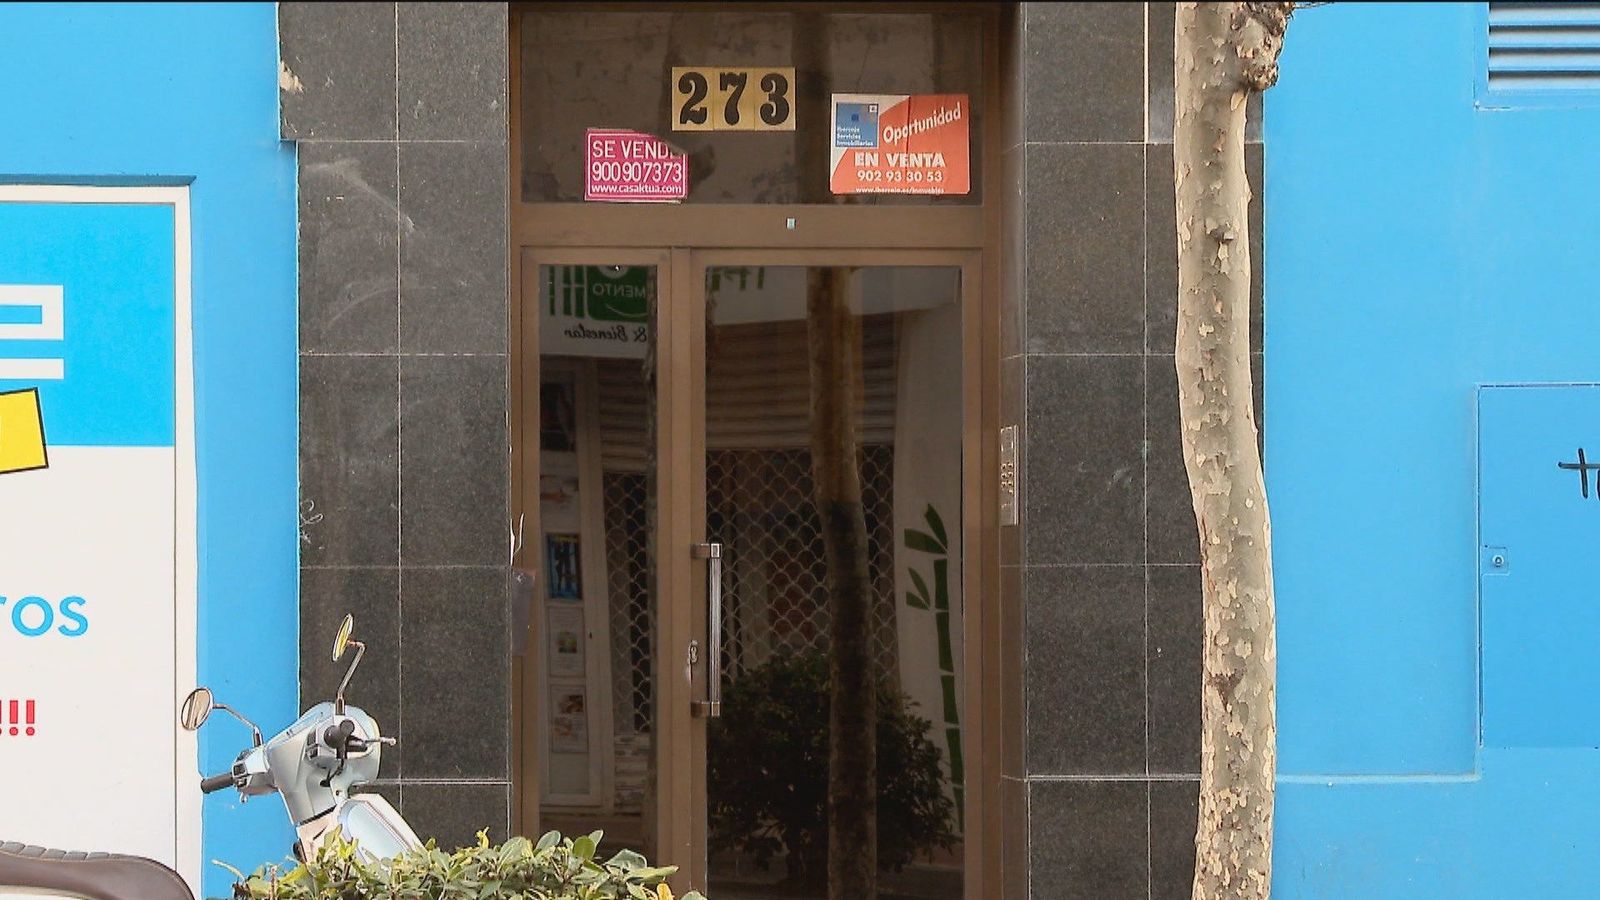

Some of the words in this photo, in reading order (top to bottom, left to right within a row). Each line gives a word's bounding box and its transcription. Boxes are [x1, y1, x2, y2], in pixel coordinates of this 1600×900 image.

[679, 72, 790, 126] 273
[883, 102, 962, 146] Oportunidad
[592, 140, 616, 158] SE
[854, 152, 879, 168] EN
[886, 153, 946, 168] VENTA
[857, 170, 882, 182] 902
[886, 171, 902, 182] 93
[906, 171, 922, 182] 30
[926, 171, 942, 182] 53
[591, 184, 682, 193] www.casaktua.com
